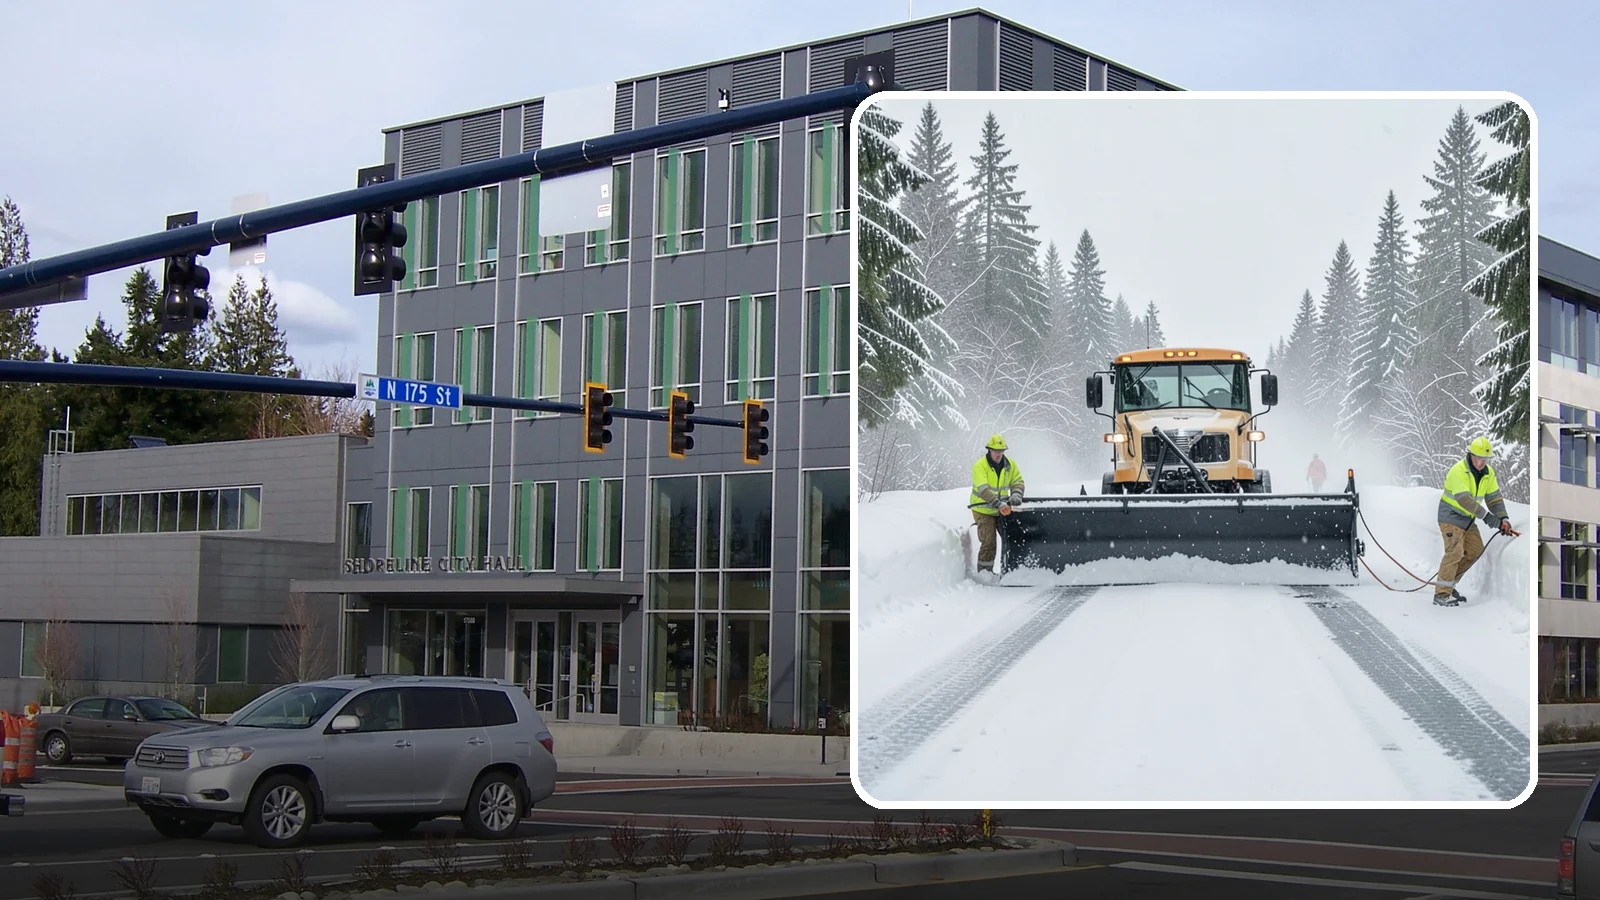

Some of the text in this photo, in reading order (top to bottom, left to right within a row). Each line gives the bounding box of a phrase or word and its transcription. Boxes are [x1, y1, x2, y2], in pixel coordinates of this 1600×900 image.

[387, 380, 451, 405] N 175 St
[344, 556, 525, 574] SHORELINE CITY HALL
